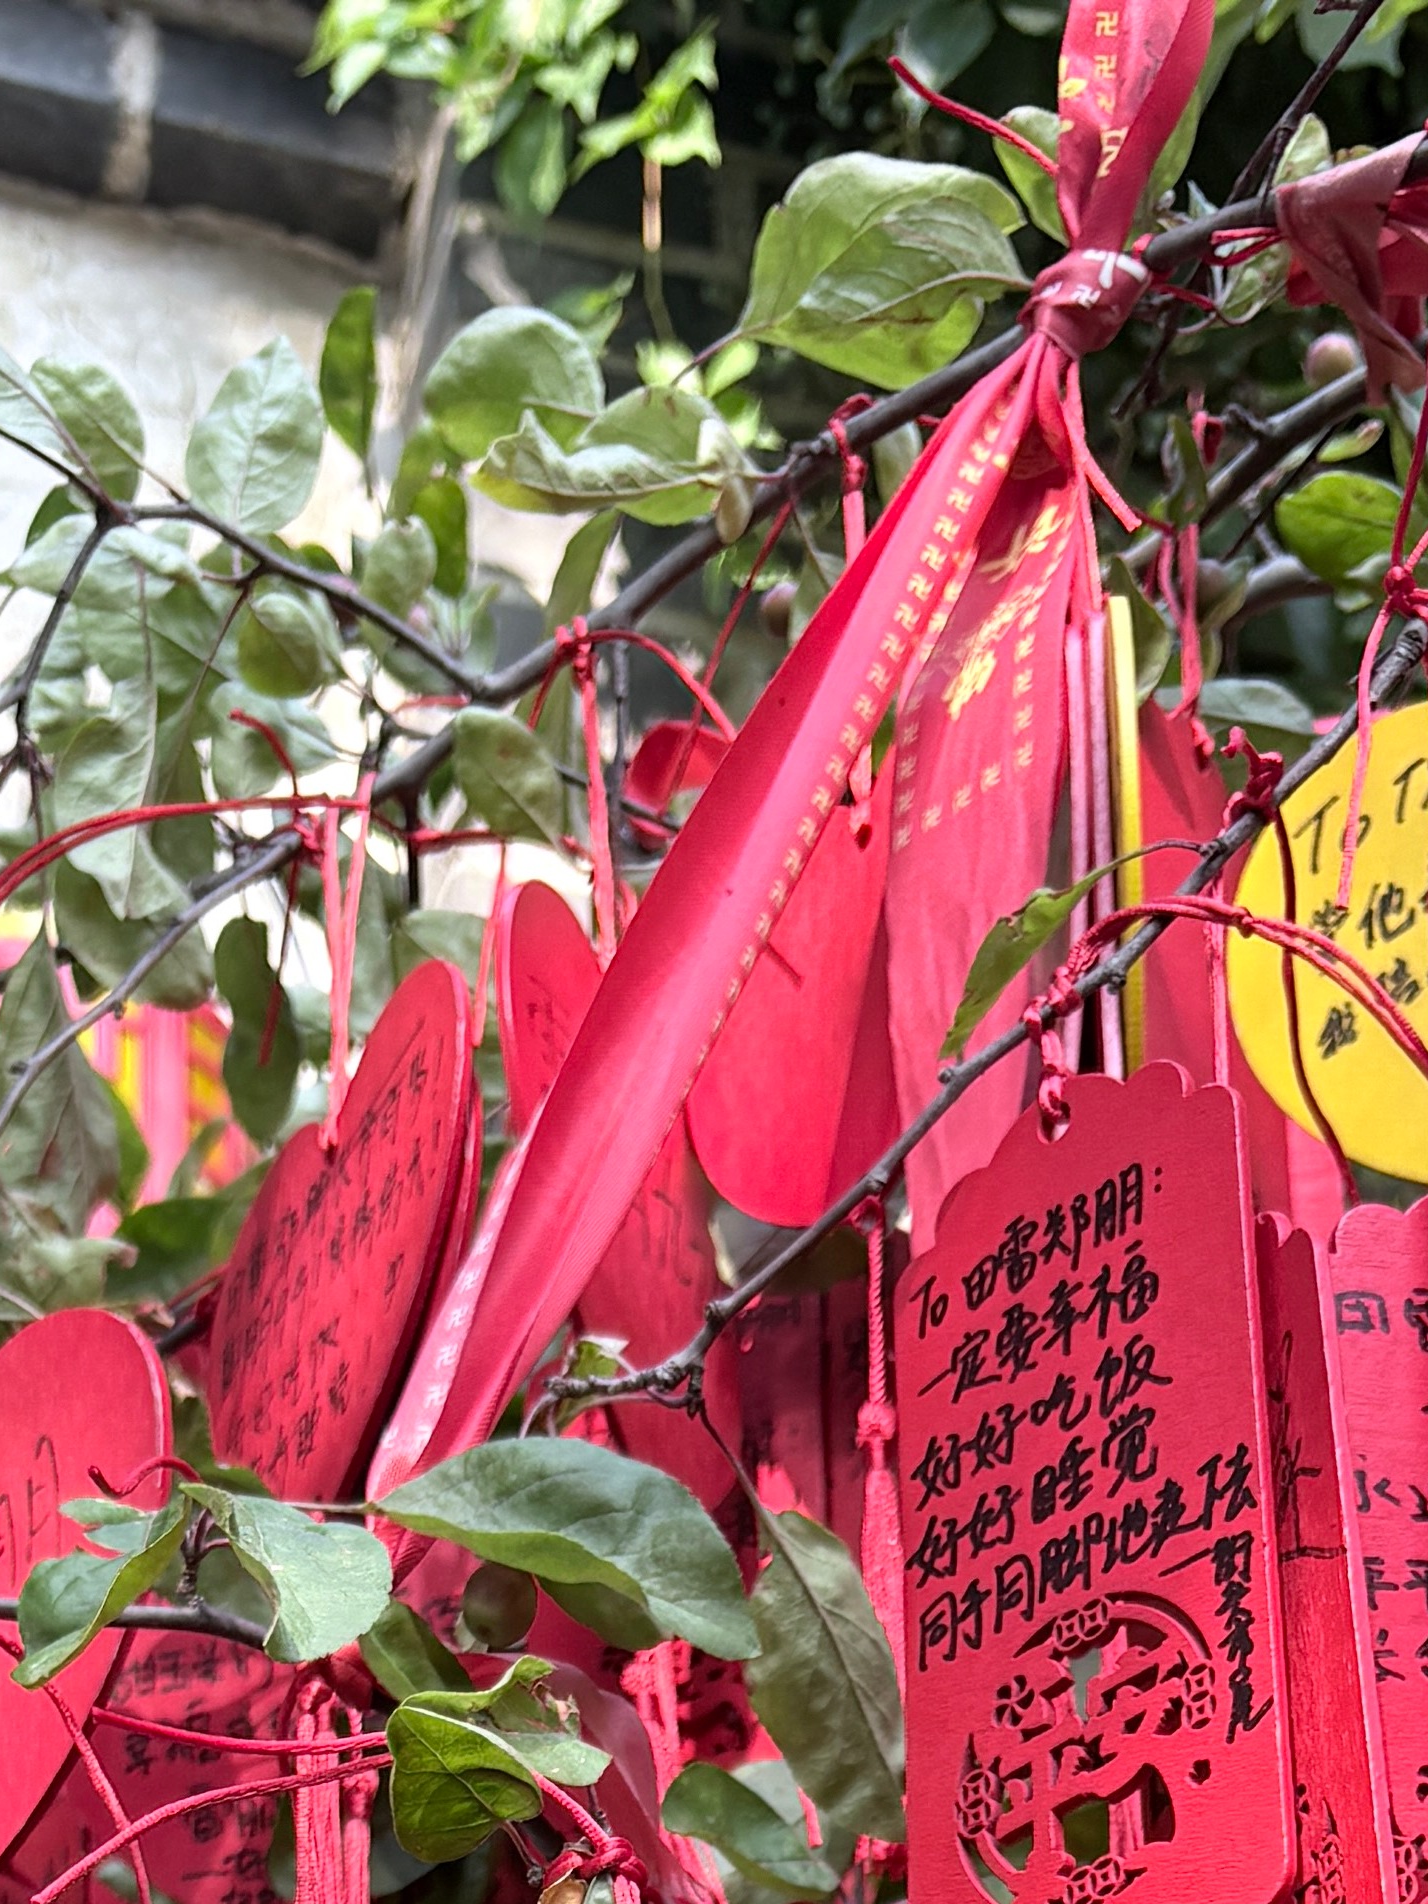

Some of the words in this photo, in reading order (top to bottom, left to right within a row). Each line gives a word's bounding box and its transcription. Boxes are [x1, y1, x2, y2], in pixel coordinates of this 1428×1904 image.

[910, 1275, 949, 1340] To
[916, 1240, 1160, 1405] 一定要幸福
[905, 1404, 1160, 1590] 好好睡觉
[910, 1334, 1173, 1512] 好好吃饭
